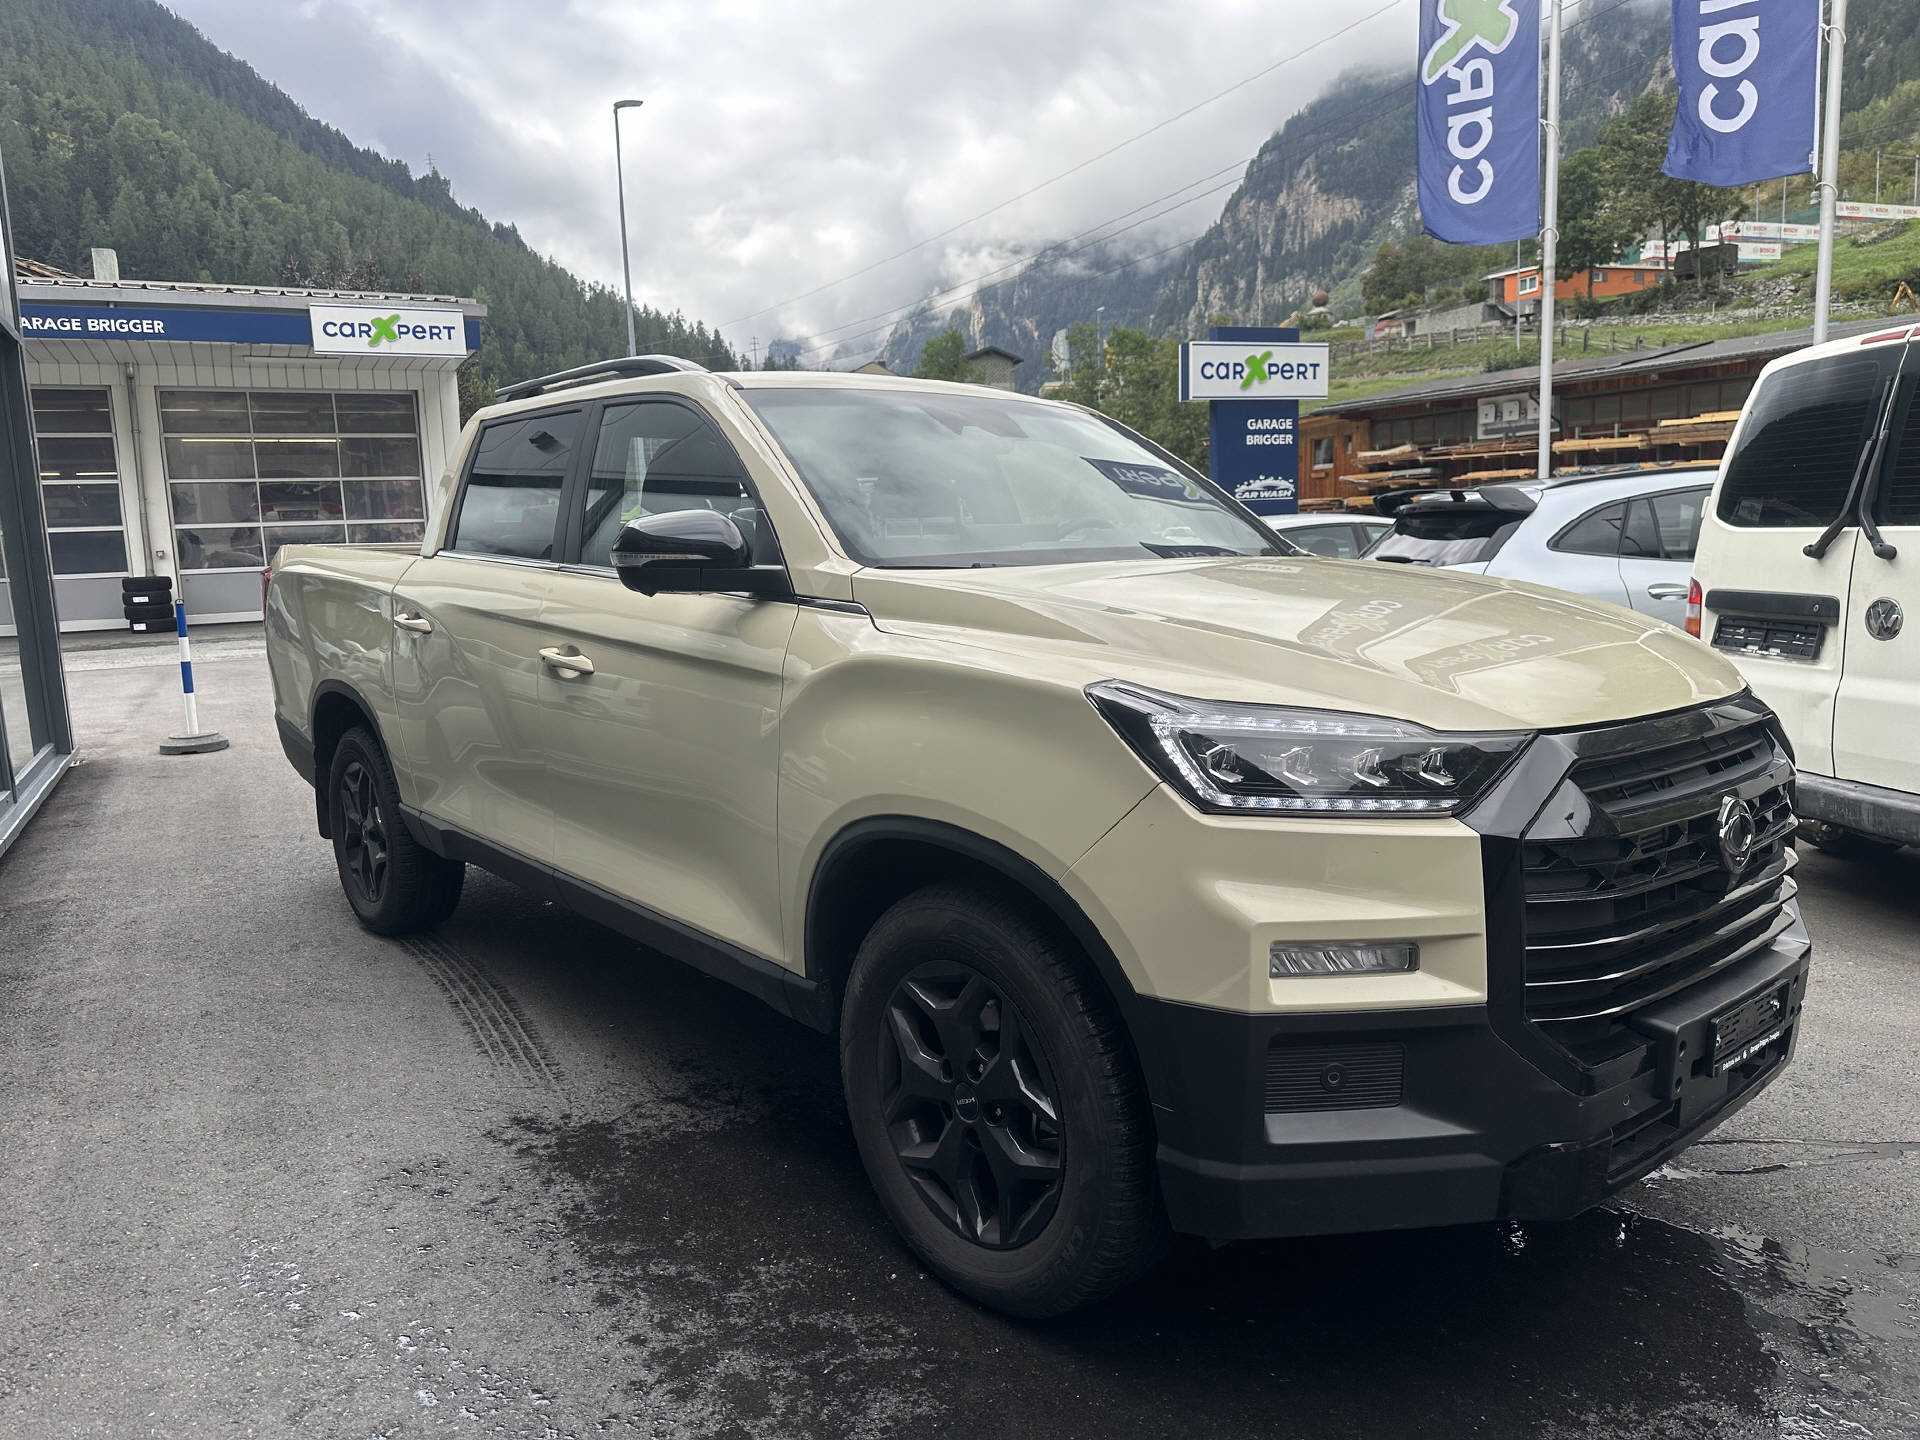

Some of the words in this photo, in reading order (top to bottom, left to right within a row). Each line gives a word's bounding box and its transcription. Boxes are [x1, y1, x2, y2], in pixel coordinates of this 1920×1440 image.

[20, 317, 82, 331] ARAGE
[87, 319, 165, 334] BRIGGER
[1246, 418, 1293, 430] GARAGE
[1245, 434, 1293, 445] BRIGGER
[1235, 491, 1259, 499] CAR
[1260, 489, 1292, 498] WASH
